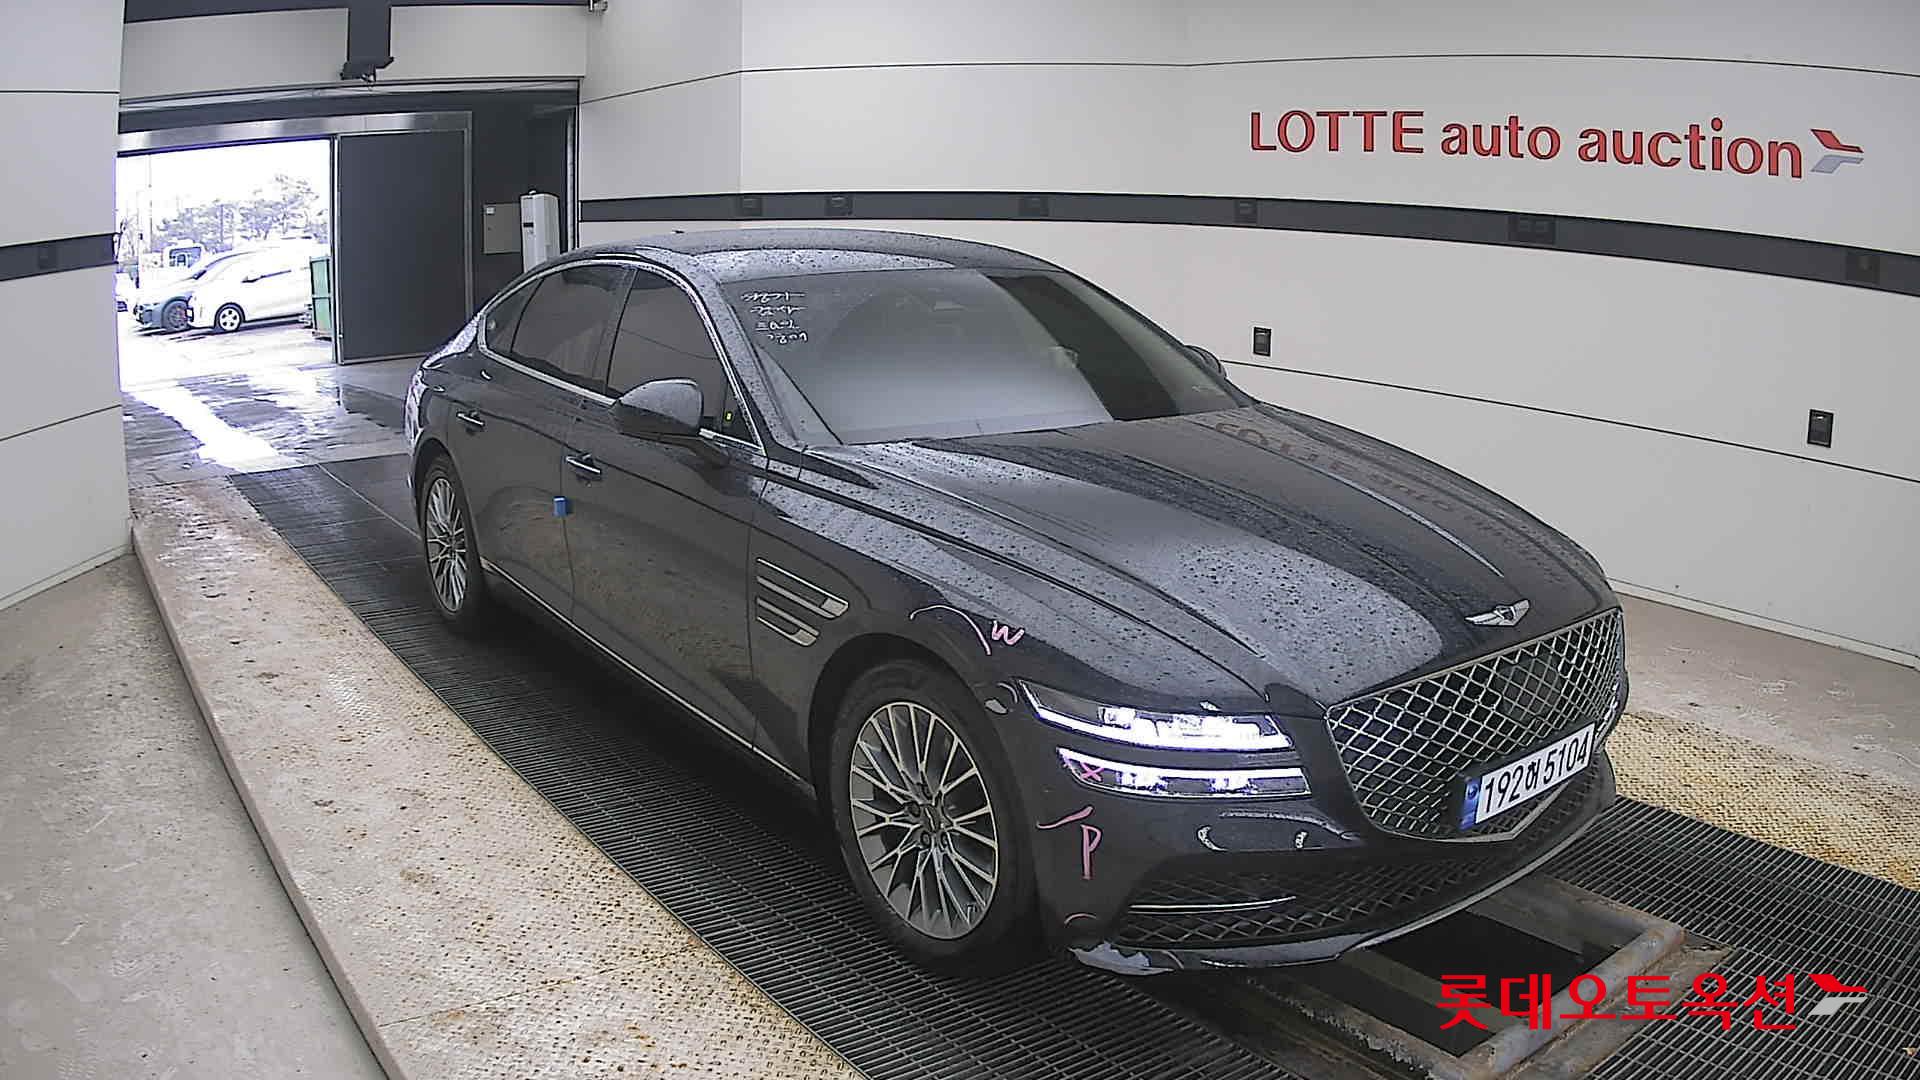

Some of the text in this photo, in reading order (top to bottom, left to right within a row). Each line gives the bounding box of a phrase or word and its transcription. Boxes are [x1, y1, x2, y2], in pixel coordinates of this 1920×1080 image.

[1250, 110, 1803, 179] LOTTE auto auction
[1485, 731, 1590, 813] 192허 5104
[1081, 823, 1103, 881] P
